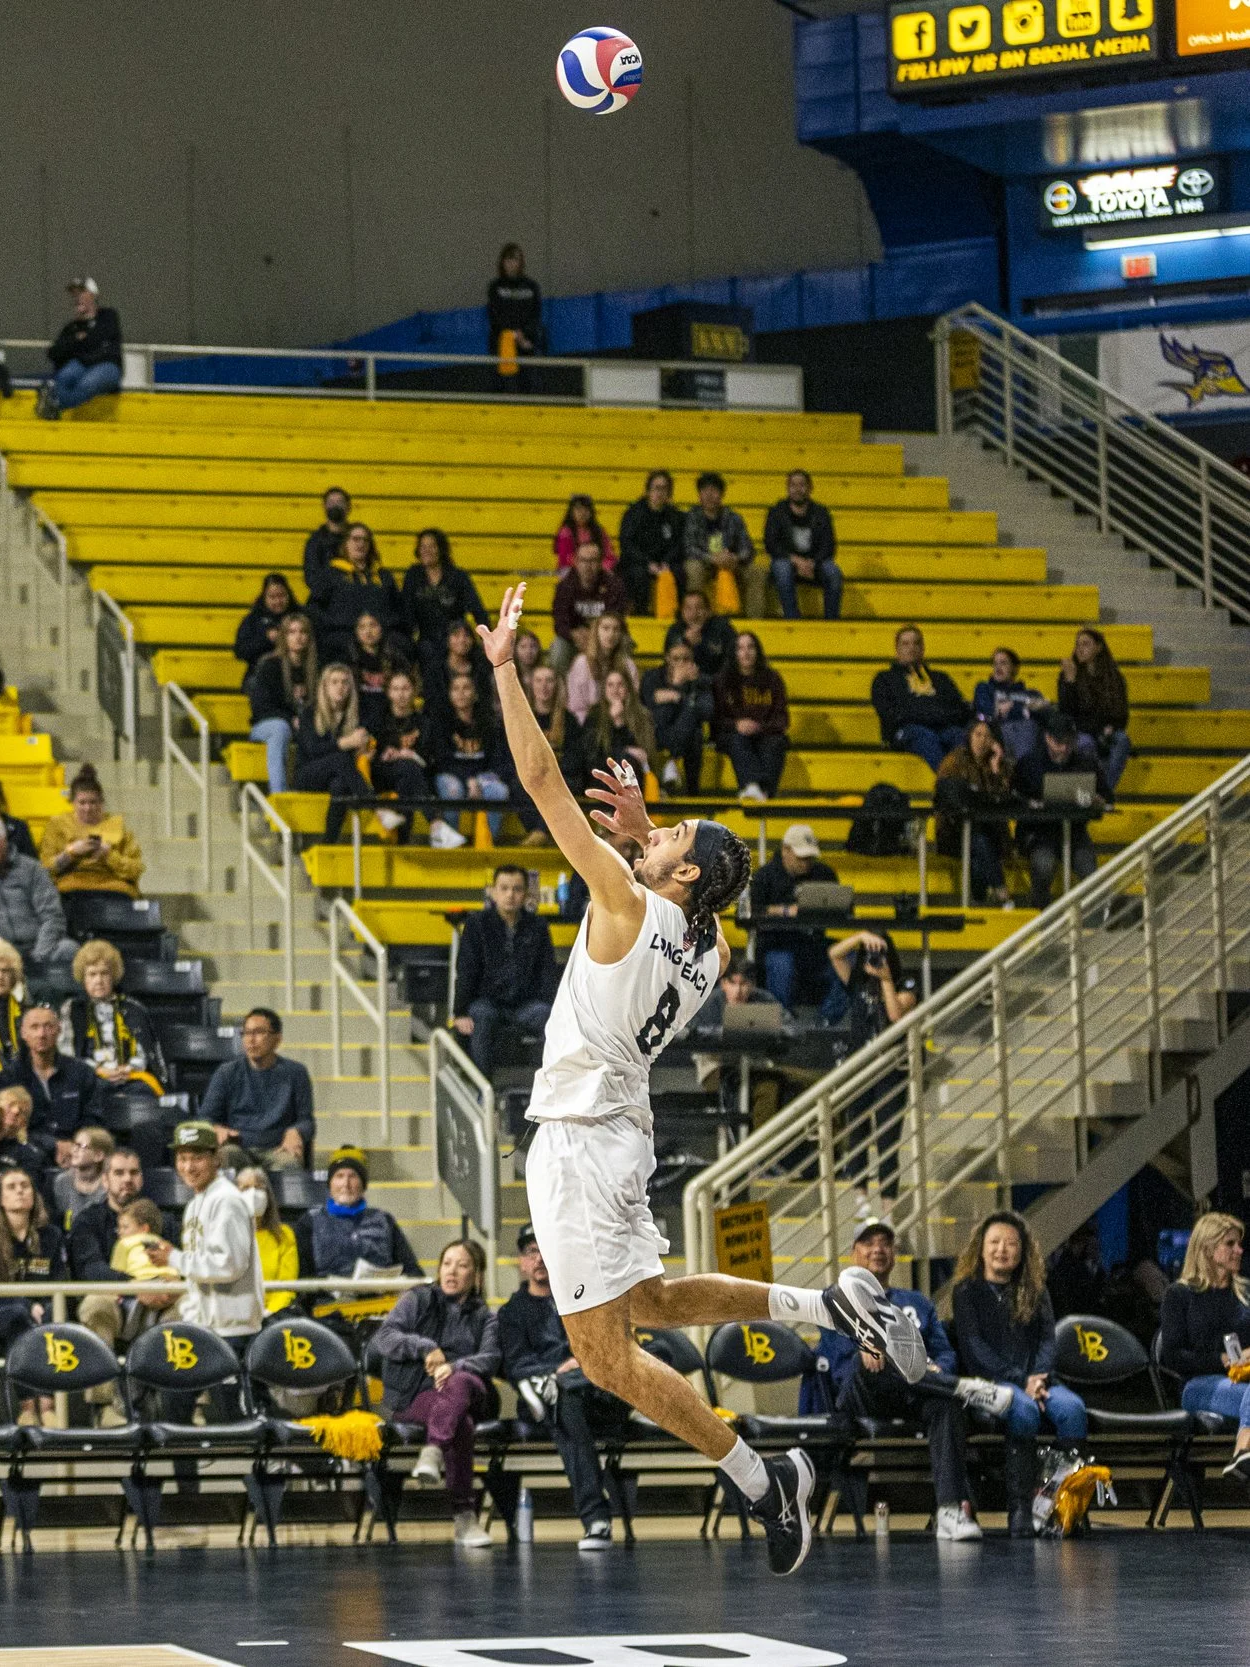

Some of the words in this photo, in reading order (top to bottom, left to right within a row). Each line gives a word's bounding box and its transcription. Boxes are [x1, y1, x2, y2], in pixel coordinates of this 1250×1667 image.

[897, 56, 972, 82] FOLLOW
[972, 54, 998, 73] US
[1000, 50, 1026, 69] ON
[1028, 42, 1091, 65] SOCIAL
[1093, 34, 1150, 58] MEDIA
[1087, 187, 1170, 213] TOYOTA
[680, 961, 708, 997] EACH
